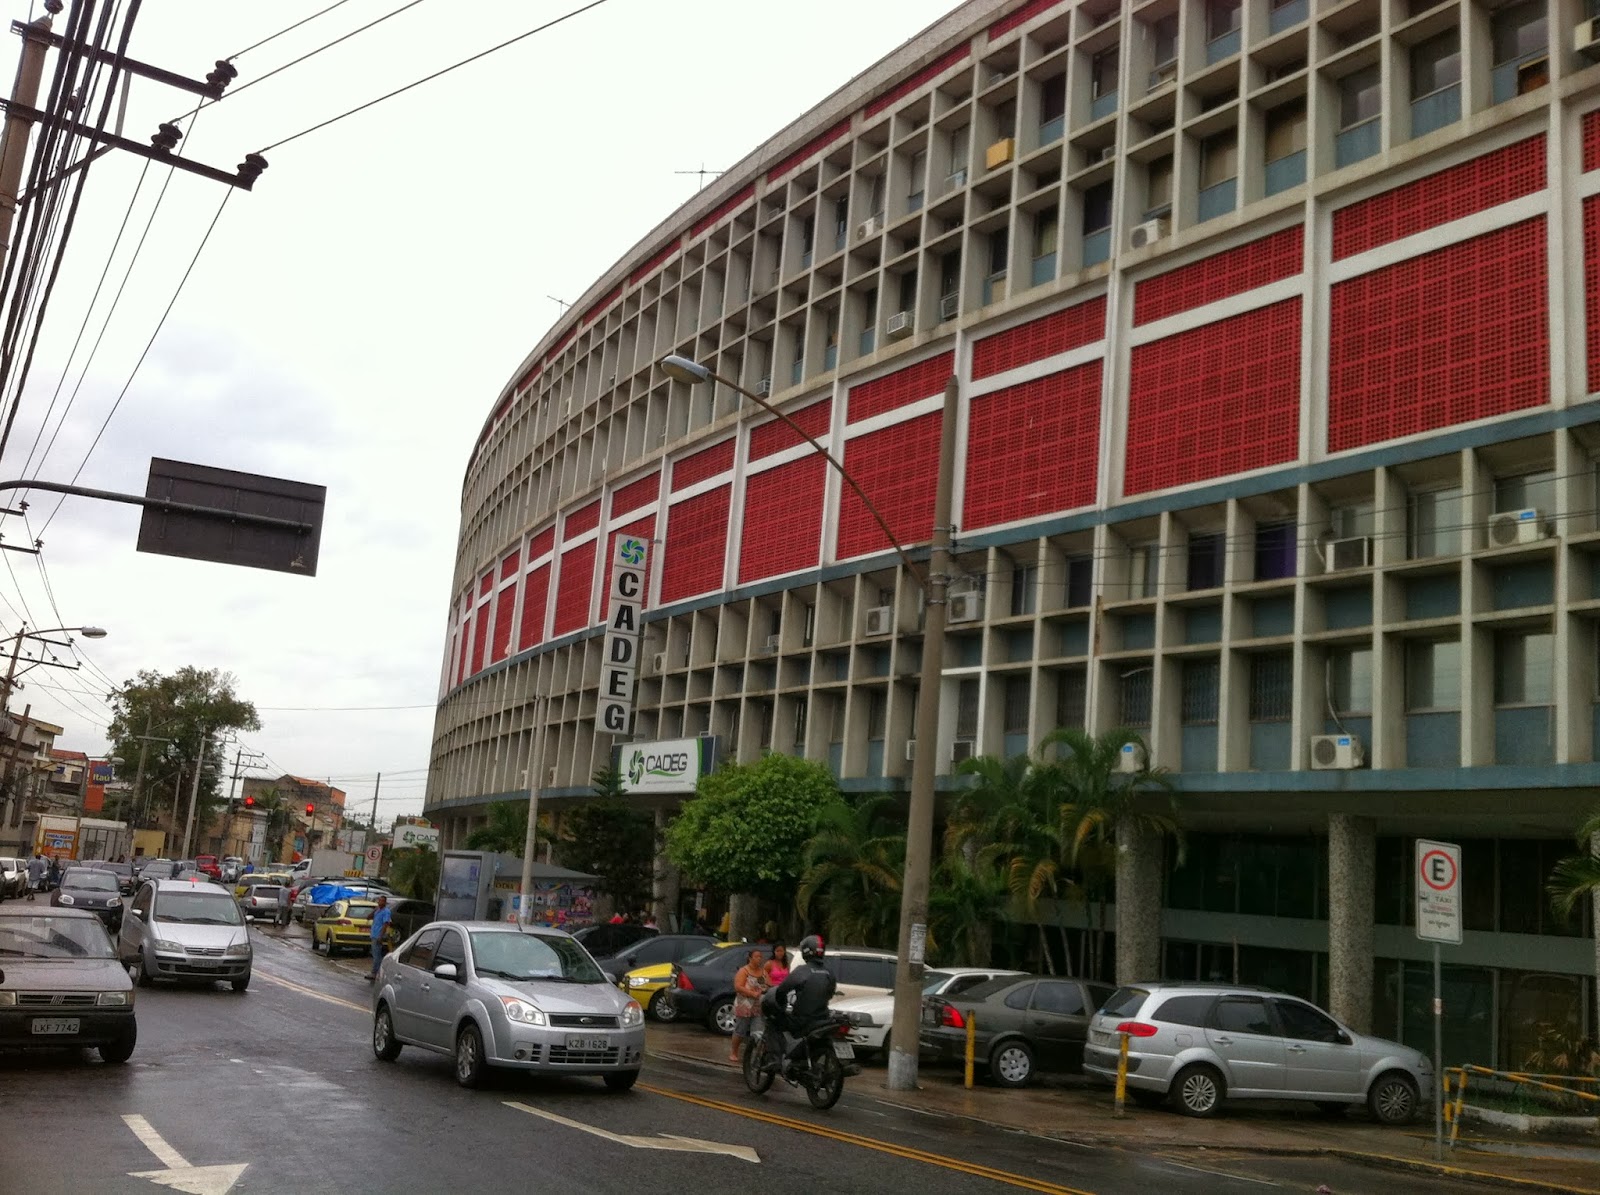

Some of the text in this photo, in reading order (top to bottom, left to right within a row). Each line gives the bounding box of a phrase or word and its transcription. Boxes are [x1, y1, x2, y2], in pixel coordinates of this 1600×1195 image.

[604, 571, 639, 731] CADEG
[646, 753, 688, 772] CADEG
[93, 774, 110, 782] Itaú
[417, 834, 438, 842] CAD
[371, 850, 377, 858] E
[1432, 858, 1445, 882] E
[34, 1024, 78, 1033] LKF 7742
